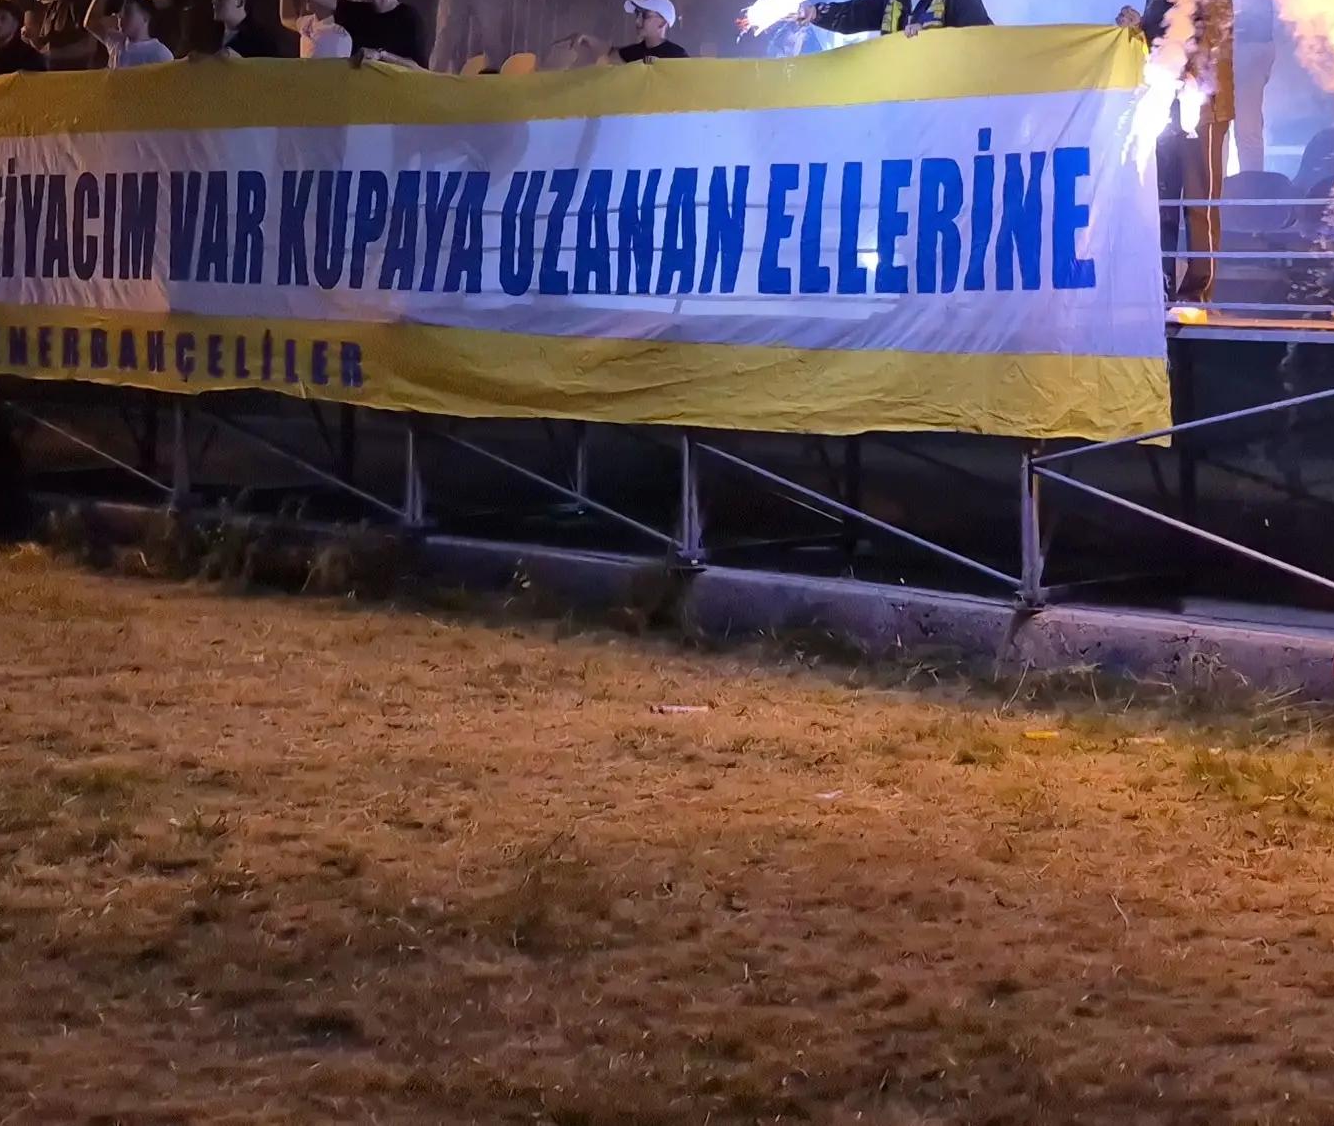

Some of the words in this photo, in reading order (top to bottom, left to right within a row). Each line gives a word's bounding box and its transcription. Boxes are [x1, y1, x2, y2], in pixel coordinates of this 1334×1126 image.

[169, 171, 265, 285] VAR
[277, 170, 490, 294] KUPAYA
[499, 164, 750, 296] UZANAN
[758, 127, 1097, 294] ELLERİNE
